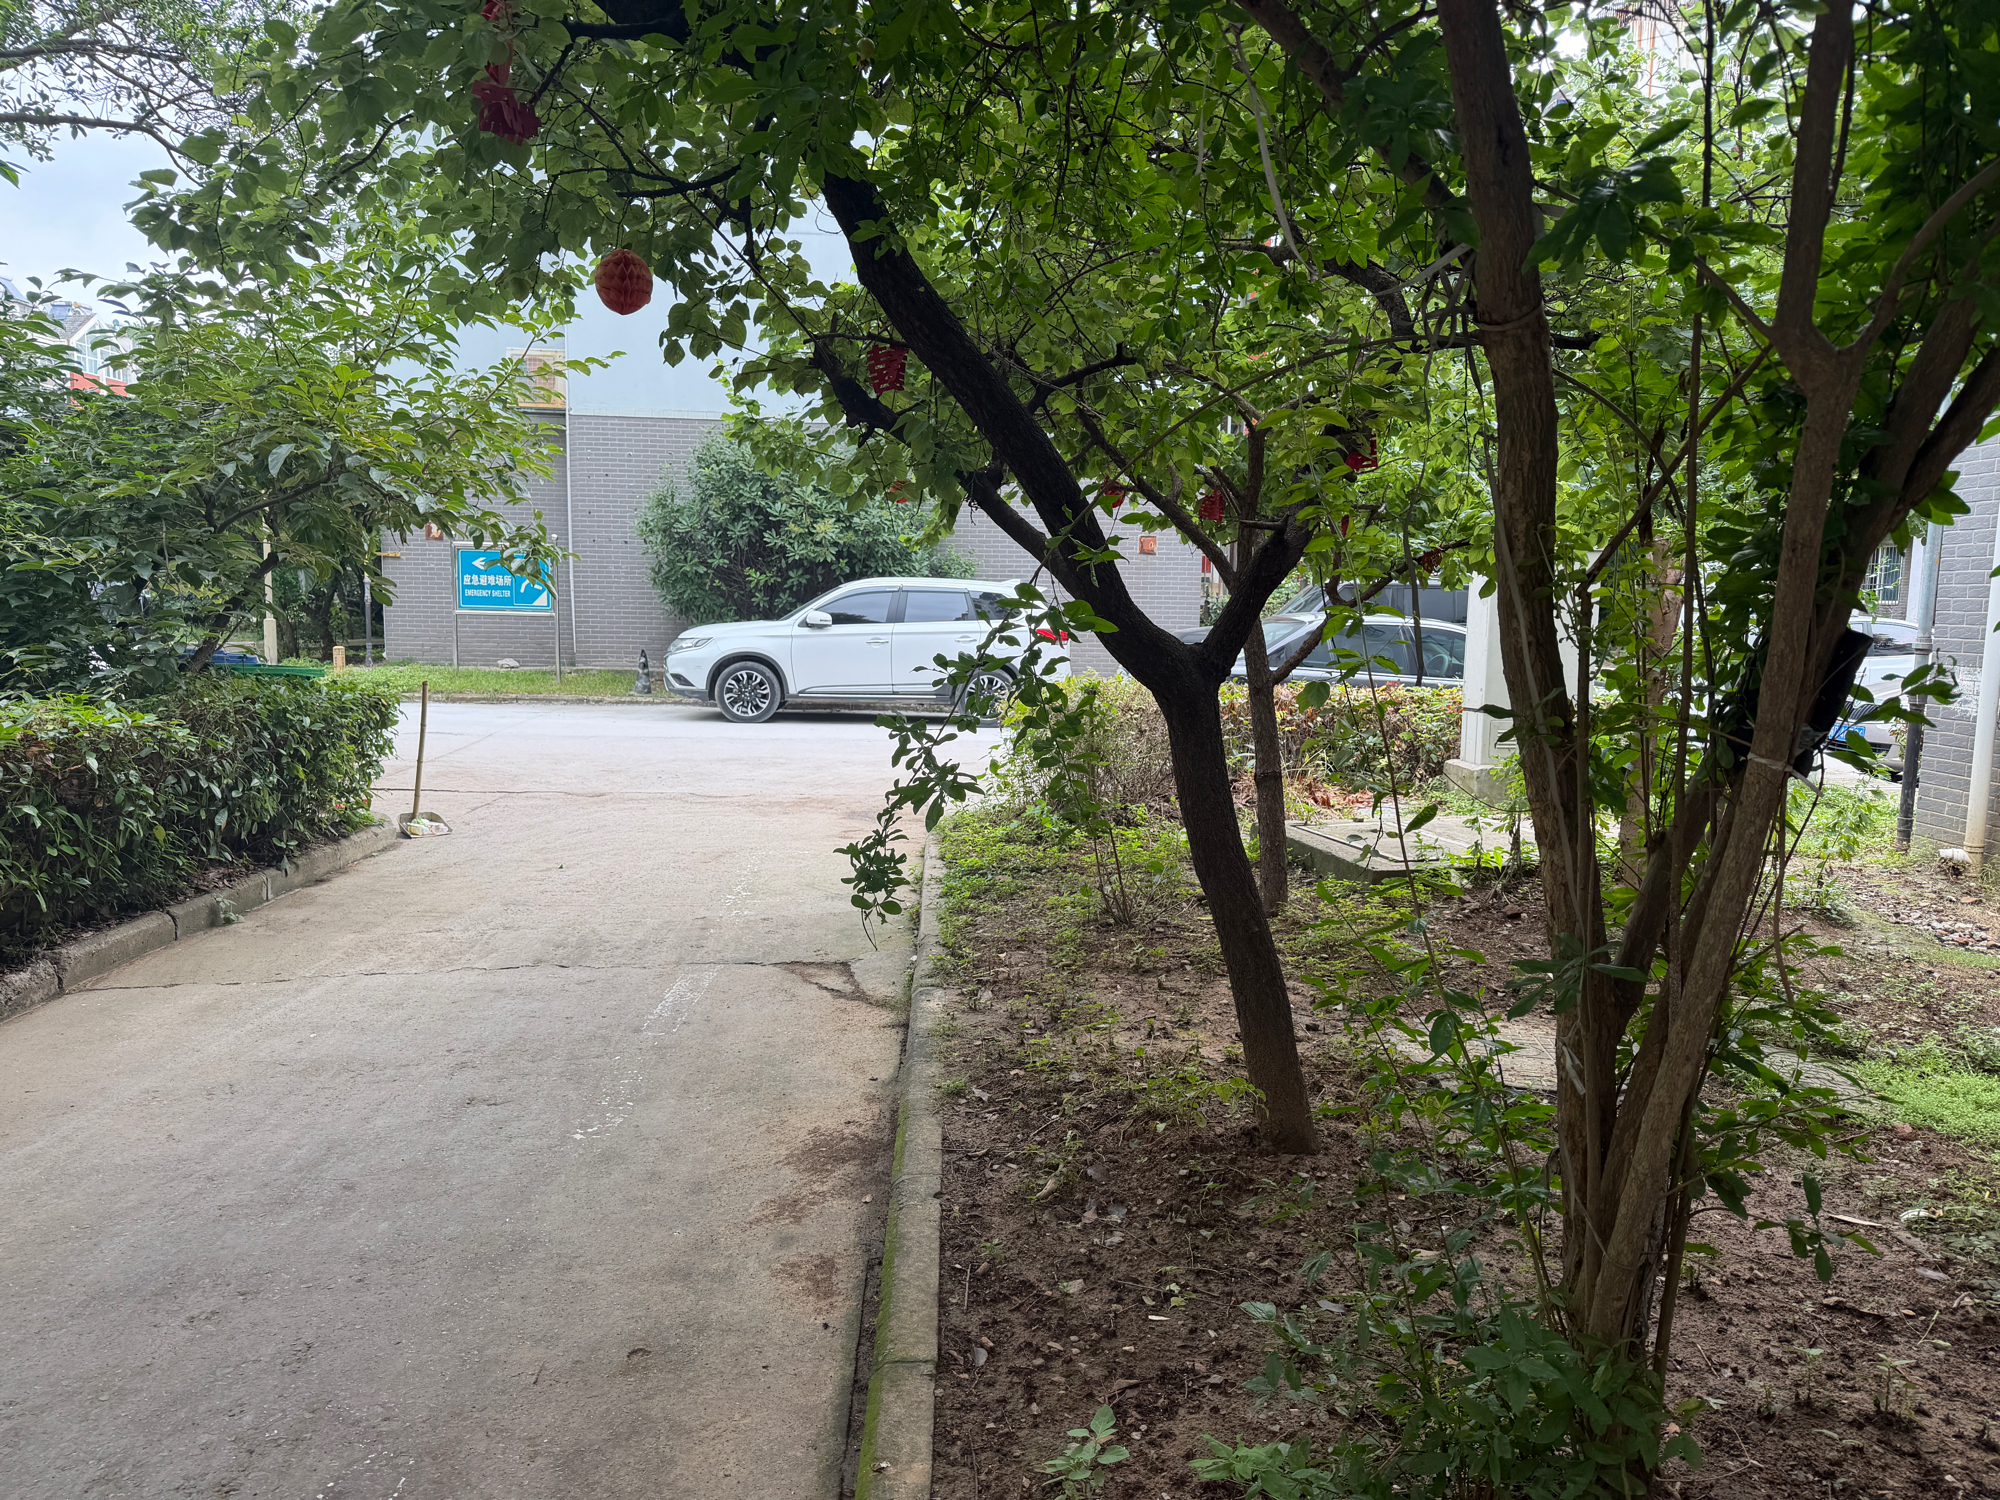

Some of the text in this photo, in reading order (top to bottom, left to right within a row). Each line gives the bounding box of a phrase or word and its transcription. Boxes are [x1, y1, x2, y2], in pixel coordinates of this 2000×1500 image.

[463, 574, 511, 586] 应急避难场所
[465, 589, 491, 597] EMERGENCY
